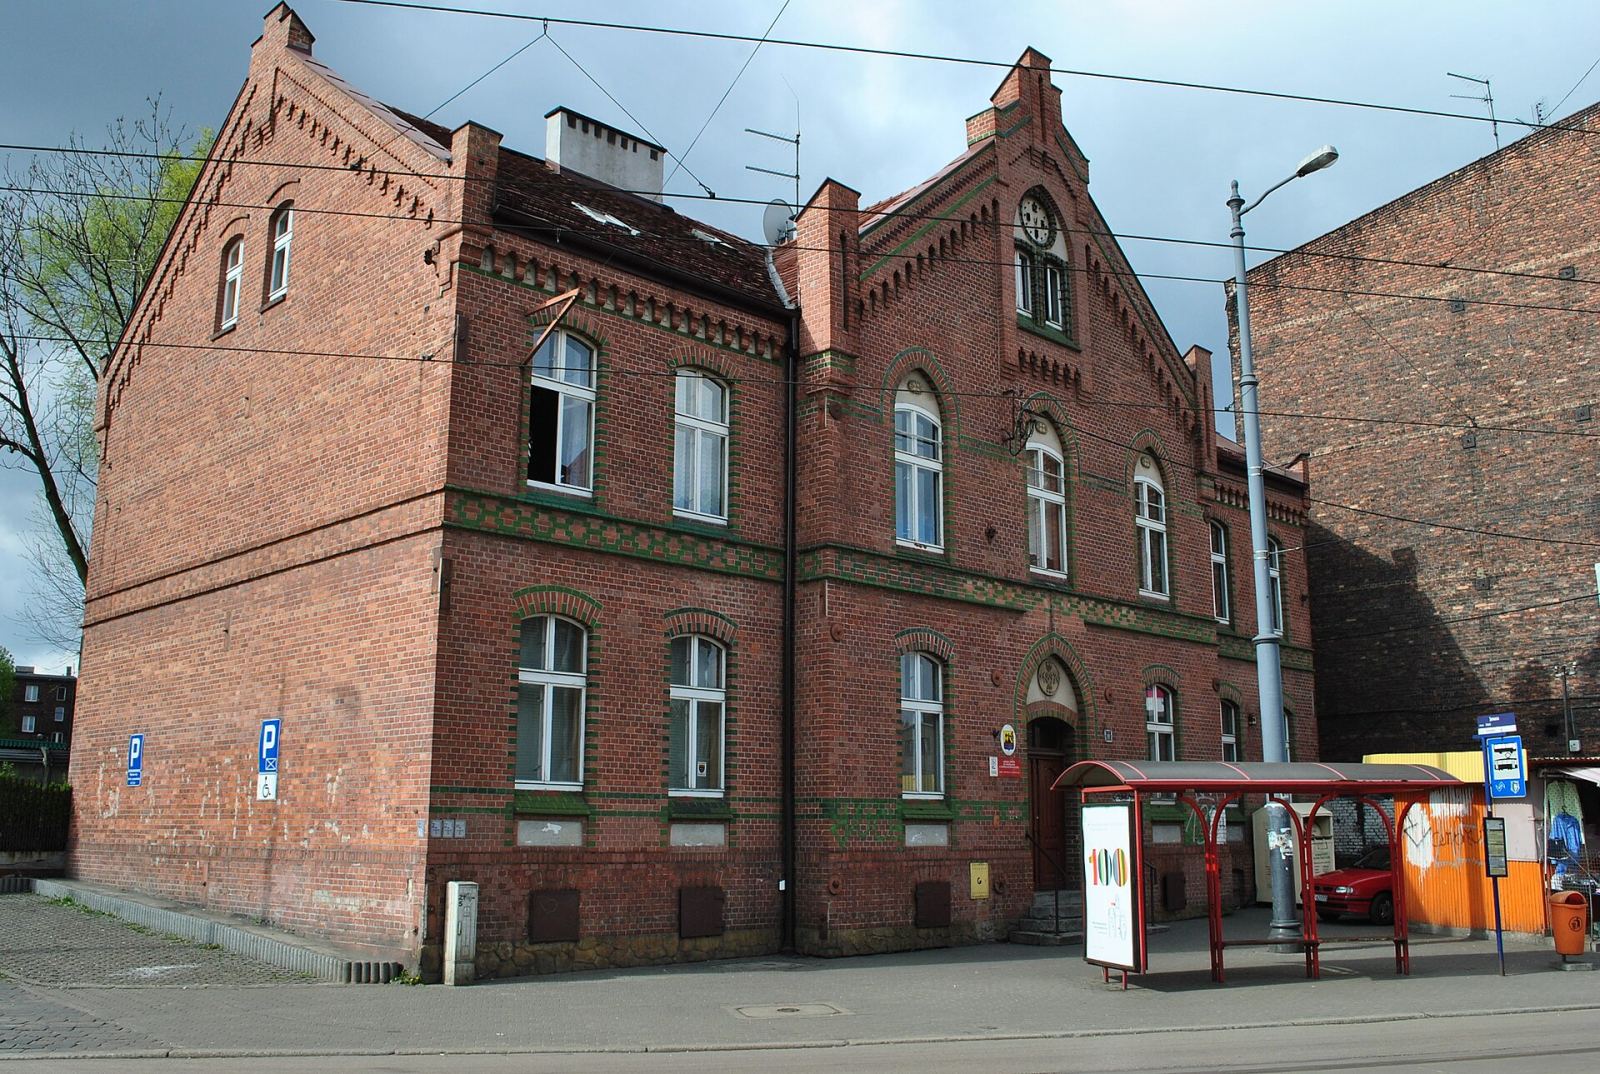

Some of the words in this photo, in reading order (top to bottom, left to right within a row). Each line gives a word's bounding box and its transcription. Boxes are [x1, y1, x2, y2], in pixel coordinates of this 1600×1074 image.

[130, 737, 141, 767] P
[262, 724, 276, 759] P
[1089, 848, 1128, 887] 100
